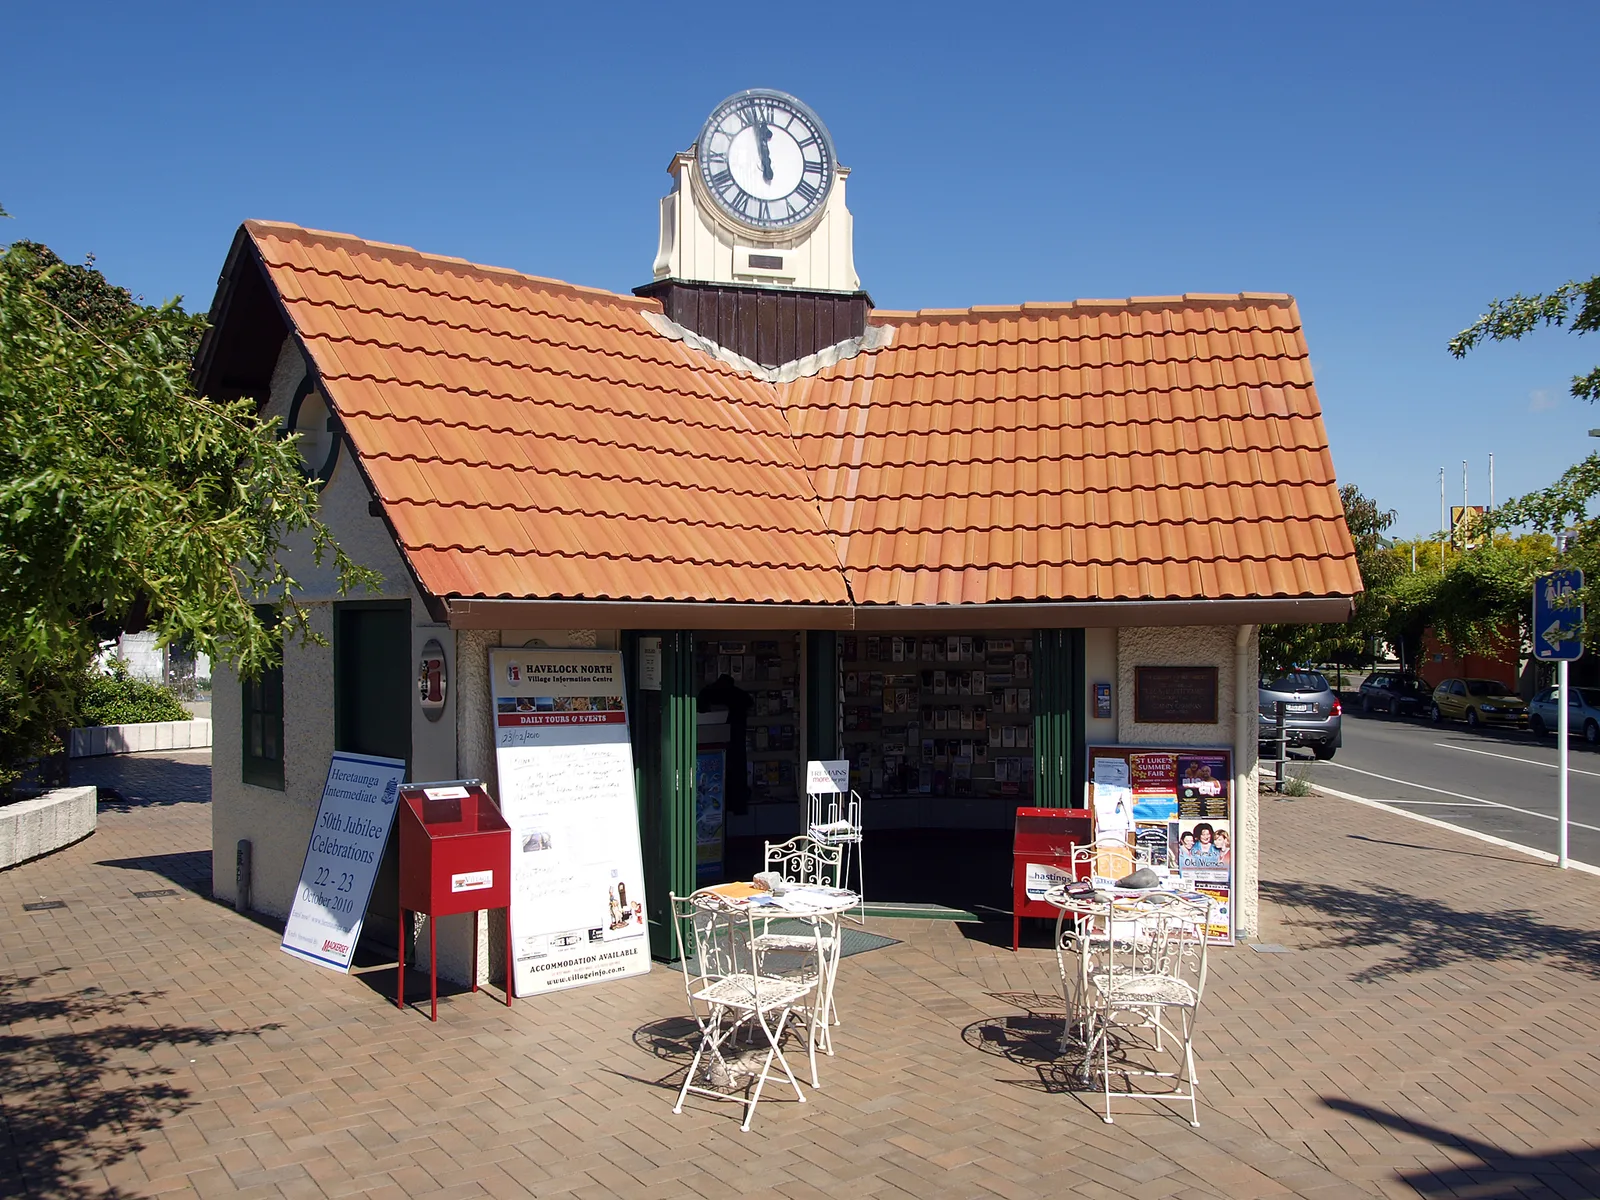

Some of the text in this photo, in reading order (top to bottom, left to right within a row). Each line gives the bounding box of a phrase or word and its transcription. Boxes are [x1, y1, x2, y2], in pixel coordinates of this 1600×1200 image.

[526, 664, 612, 674] HAVELOCK NORTH
[528, 676, 551, 684] Village
[553, 676, 591, 684] Information
[520, 716, 544, 724] DAILY
[331, 768, 380, 787] Heretaunga
[325, 785, 378, 804] Intermediate
[320, 811, 383, 839] 50th Jubilee
[311, 834, 375, 864] Celebrations
[314, 866, 328, 887] 22
[337, 872, 354, 893] 23
[1034, 872, 1072, 884] hastings
[302, 887, 354, 914] October 2010
[530, 955, 597, 974] ACCOMMODATION
[598, 948, 638, 961] AVAILABLE
[546, 966, 626, 986] www.villageinfo.co.nz
